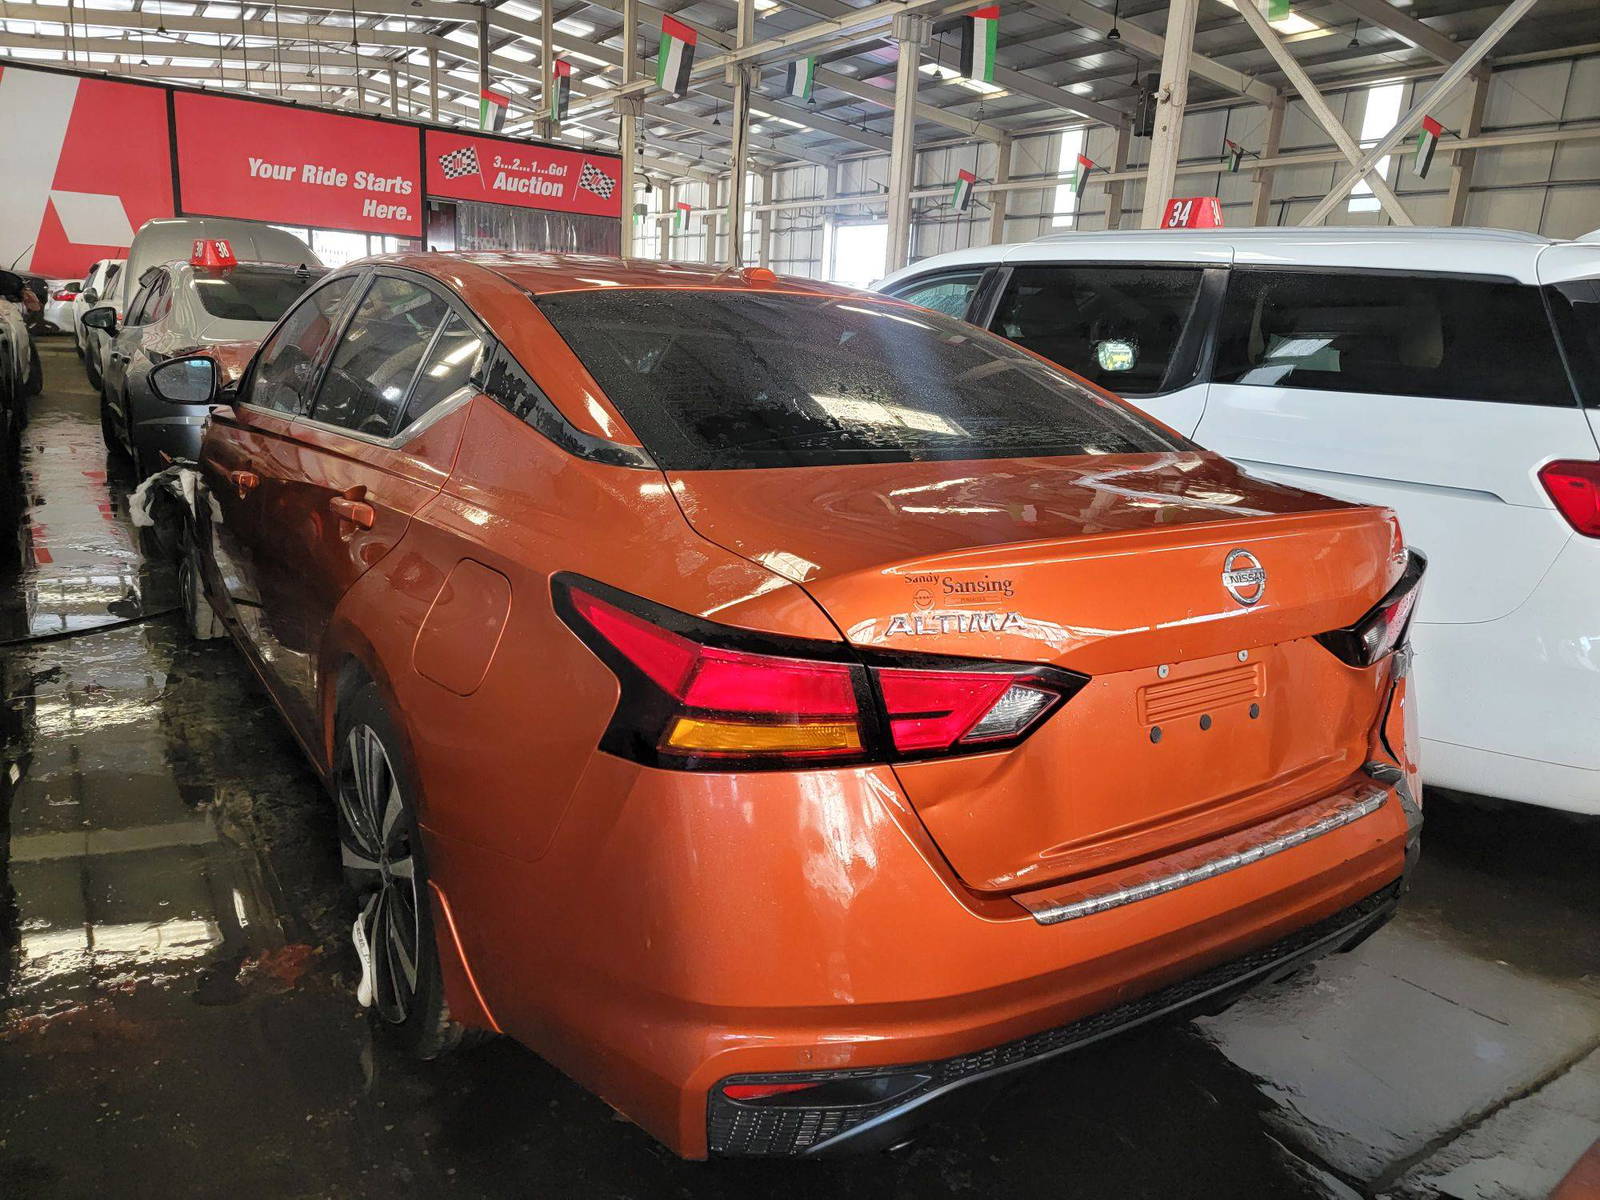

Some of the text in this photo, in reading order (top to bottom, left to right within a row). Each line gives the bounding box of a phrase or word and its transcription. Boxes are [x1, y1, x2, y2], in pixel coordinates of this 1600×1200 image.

[248, 157, 413, 195] Your Ride Starts
[492, 171, 565, 198] Auction
[362, 198, 413, 222] Here.
[1169, 200, 1193, 227] 34
[904, 571, 940, 585] Sandy
[942, 574, 1014, 597] Sansing
[1229, 572, 1265, 583] NISSAN
[885, 611, 1027, 637] ALTIMA
